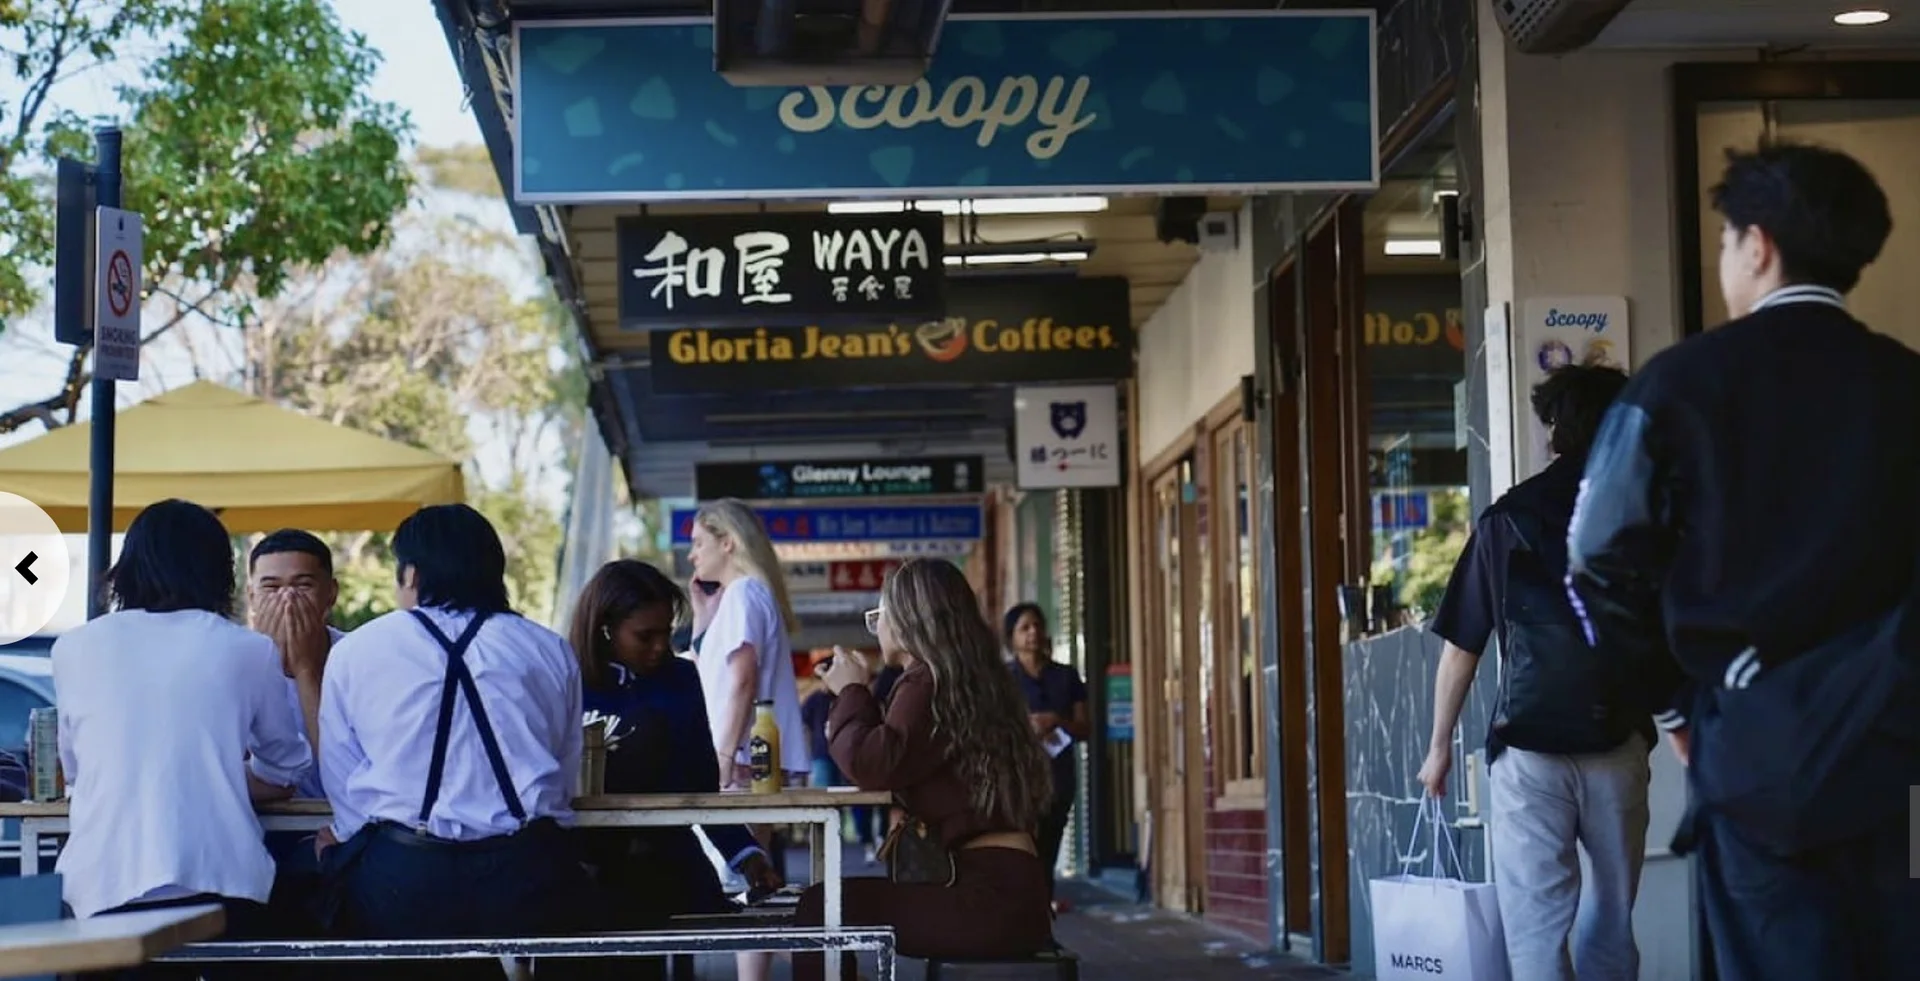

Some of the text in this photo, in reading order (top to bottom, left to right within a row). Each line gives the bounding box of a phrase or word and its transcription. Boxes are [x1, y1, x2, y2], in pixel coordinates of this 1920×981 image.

[779, 75, 1096, 159] Scoopy
[633, 230, 792, 309] 和屋
[813, 228, 929, 270] WAYA
[668, 317, 1113, 363] Gloria Jean's Coffees
[1545, 308, 1608, 332] Scoopy
[793, 465, 859, 484] Glenny
[863, 462, 931, 482] Lounge
[1391, 953, 1443, 975] MARCS
